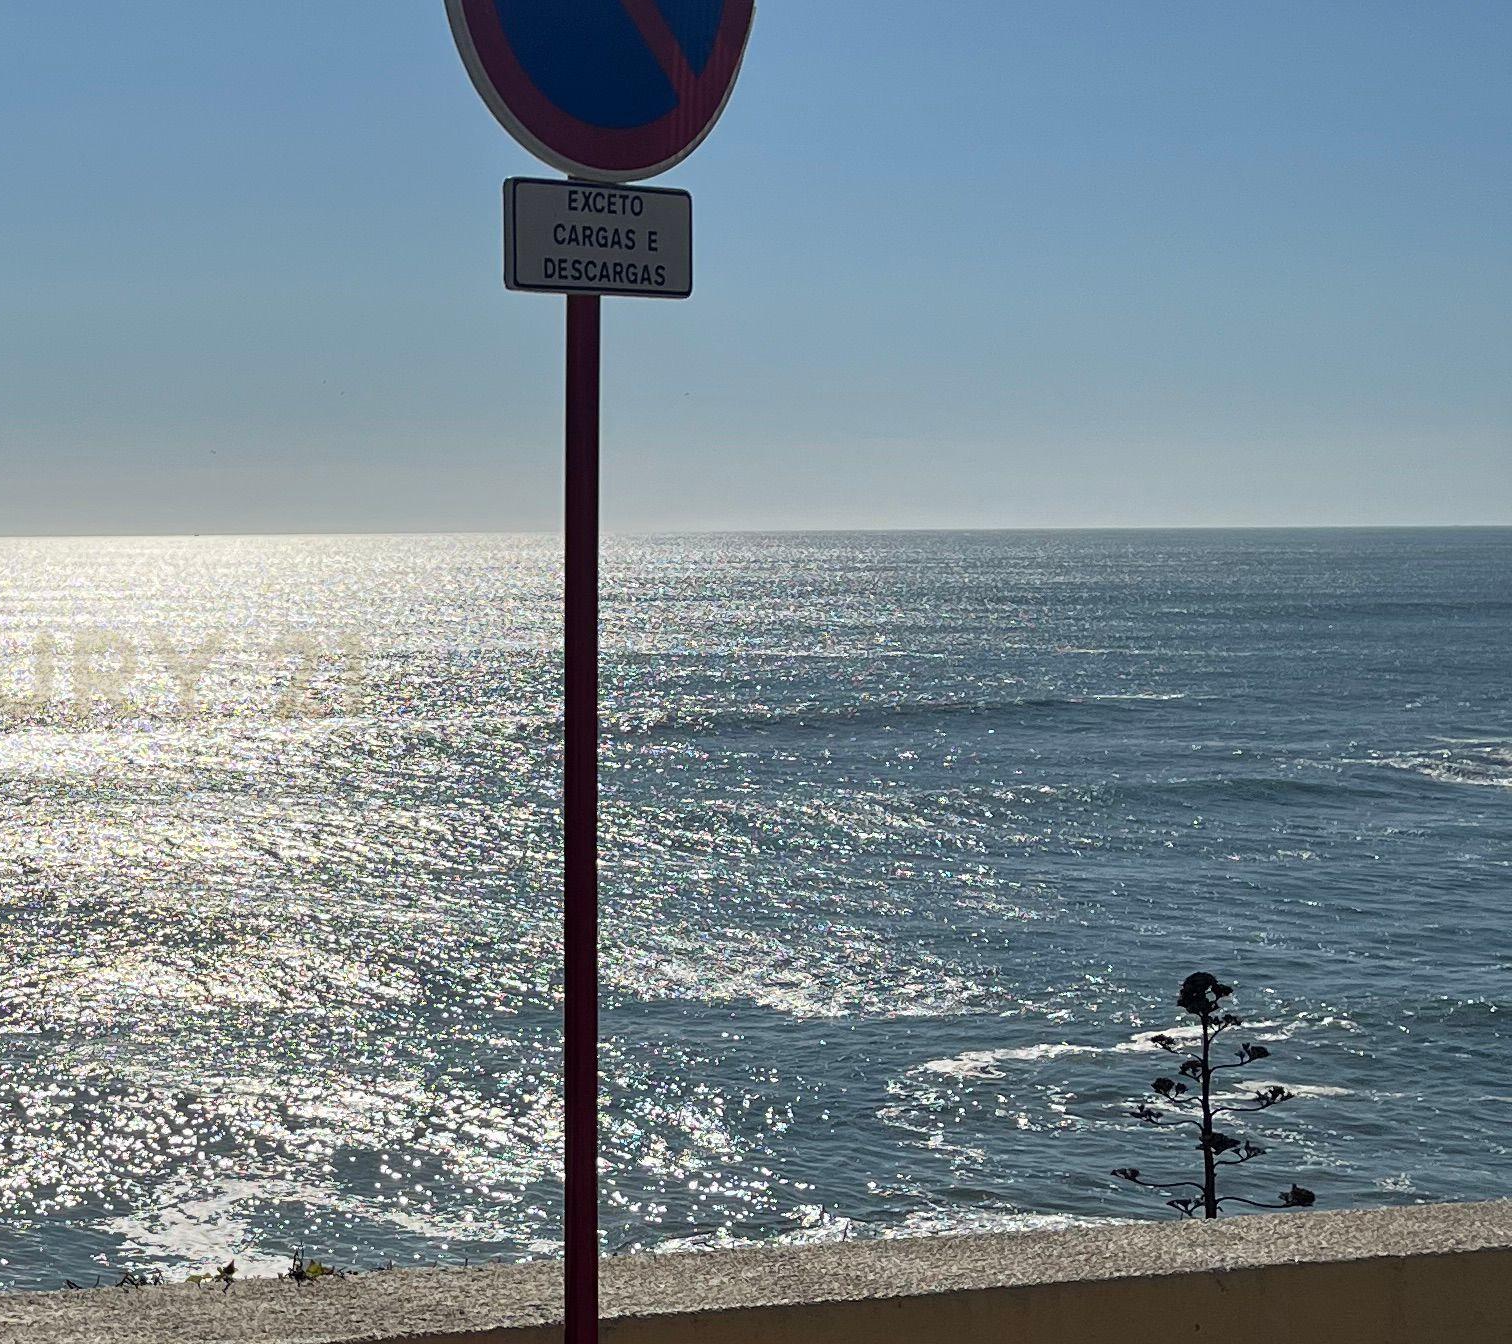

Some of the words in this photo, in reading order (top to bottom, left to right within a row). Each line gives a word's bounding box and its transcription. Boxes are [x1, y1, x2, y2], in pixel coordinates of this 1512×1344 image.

[568, 190, 643, 217] EXCETO
[553, 223, 636, 251] CARGAS
[648, 230, 659, 252] E
[543, 258, 666, 287] DESCARGAS
